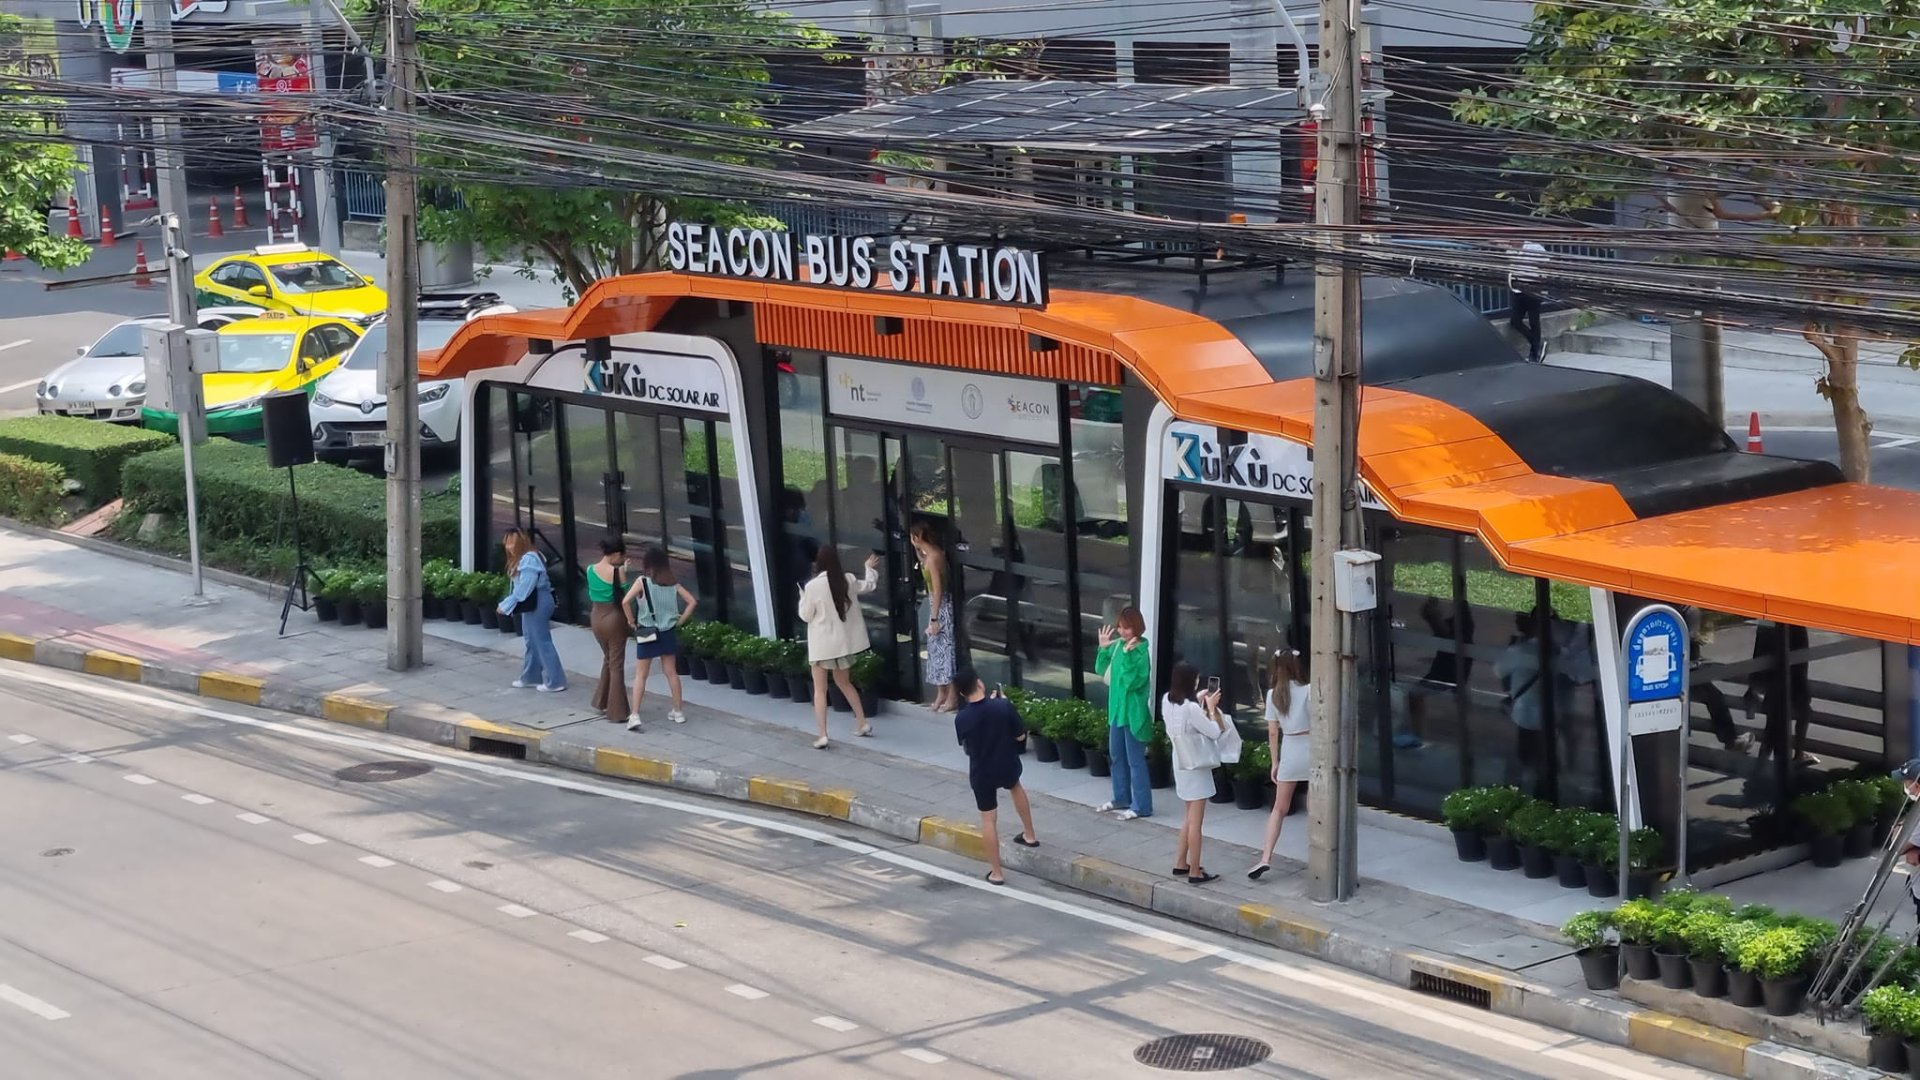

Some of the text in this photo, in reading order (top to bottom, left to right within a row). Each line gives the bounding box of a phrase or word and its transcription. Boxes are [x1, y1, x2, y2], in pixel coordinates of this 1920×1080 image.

[668, 222, 1043, 304] SEACON BUS STATION
[648, 385, 666, 400] DC
[667, 387, 701, 405] SOLAR
[703, 392, 720, 408] AIR
[850, 384, 866, 402] nt
[1008, 396, 1050, 415] SEACON
[1273, 473, 1296, 492] DC
